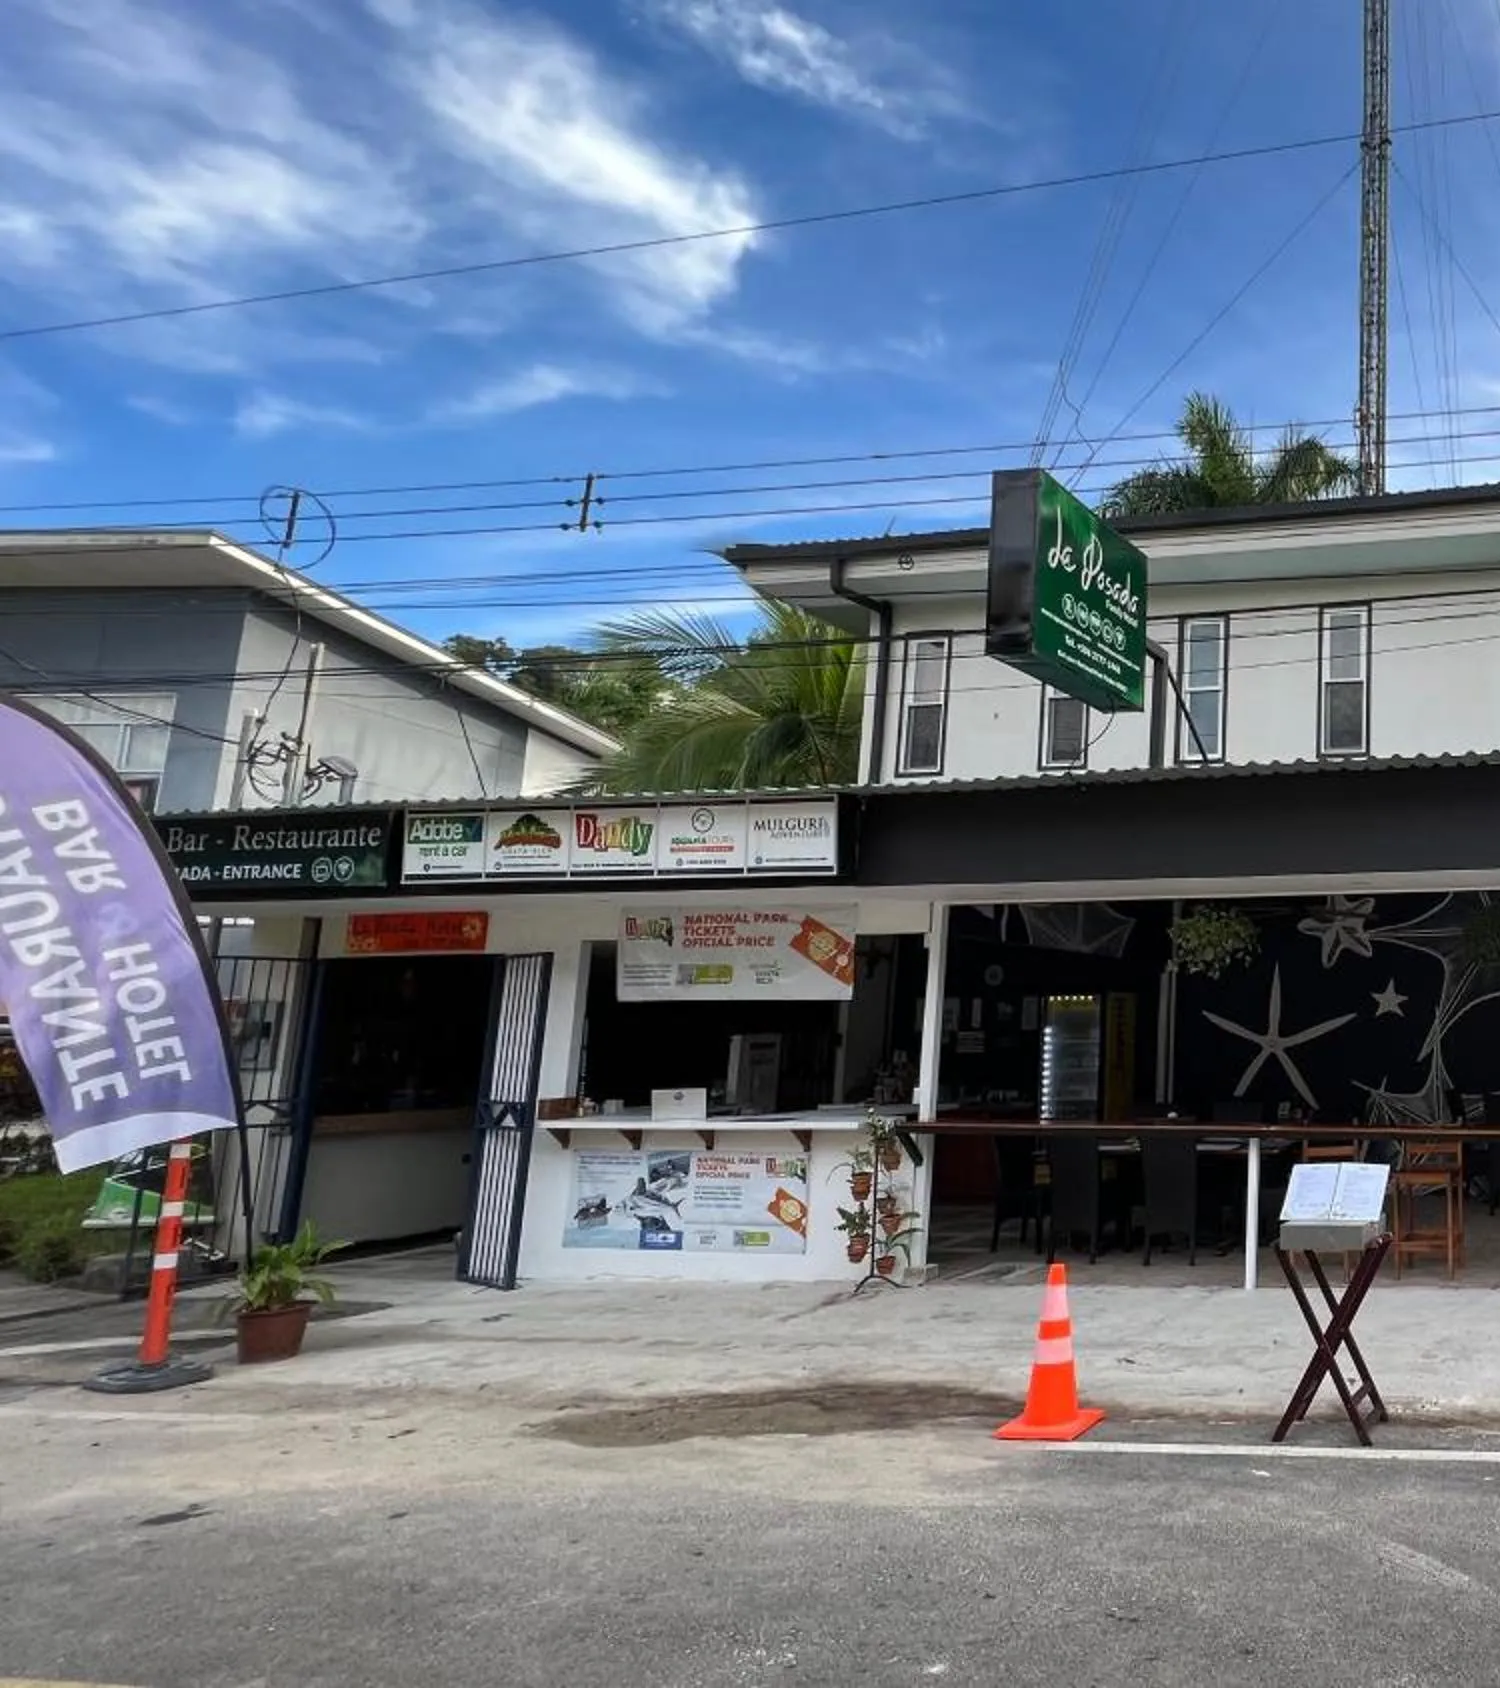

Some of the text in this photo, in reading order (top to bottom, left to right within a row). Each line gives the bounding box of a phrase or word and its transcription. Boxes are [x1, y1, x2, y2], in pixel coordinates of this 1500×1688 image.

[168, 827, 209, 850] Bar
[233, 825, 382, 850] Restaurante
[410, 819, 463, 841] Adobe
[576, 814, 653, 855] Dandy
[174, 866, 211, 881] ADA
[222, 864, 301, 880] ENTRANCE
[684, 913, 749, 925] NATIONAL
[683, 925, 735, 936] TICKETS
[735, 936, 775, 947] PRICE
